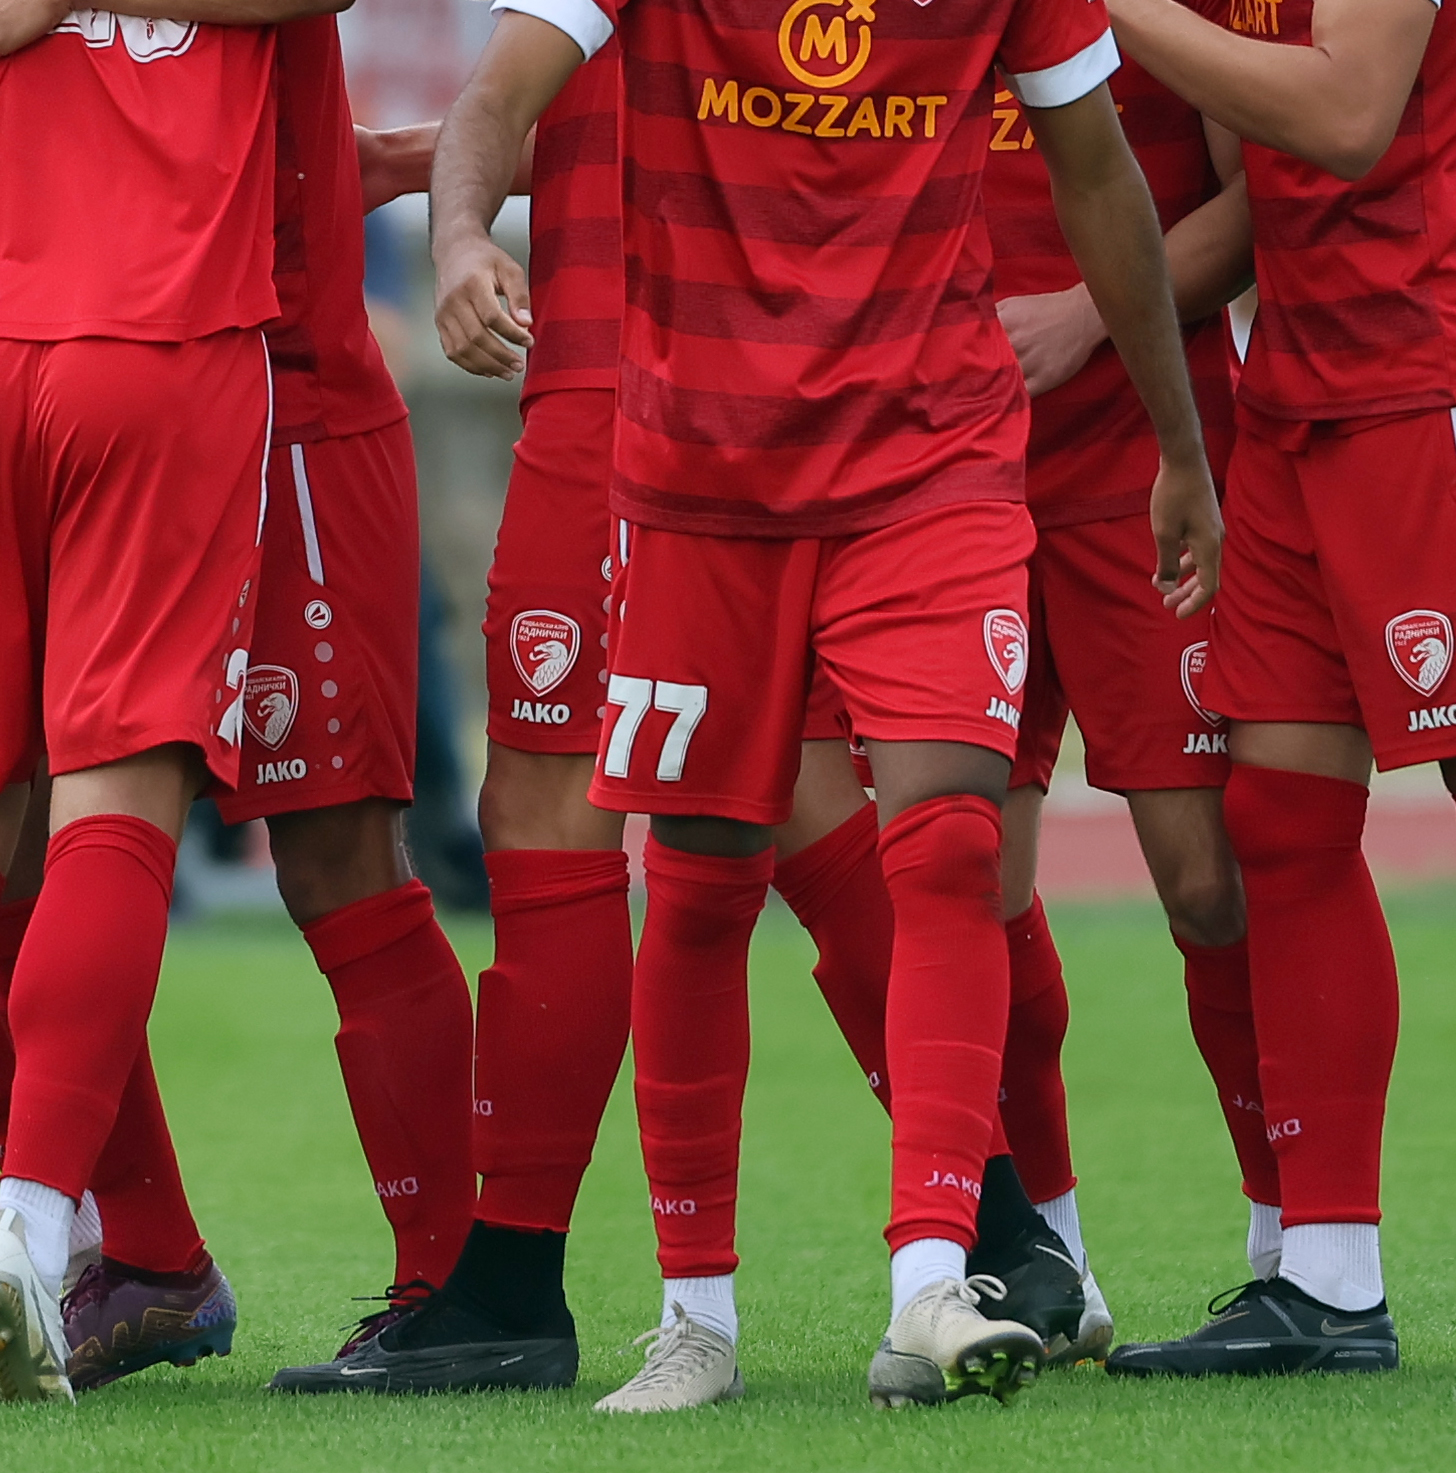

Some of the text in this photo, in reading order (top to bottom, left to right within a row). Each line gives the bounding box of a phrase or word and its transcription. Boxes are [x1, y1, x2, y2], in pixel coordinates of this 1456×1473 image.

[697, 77, 948, 139] MOZZART
[511, 698, 570, 725] JAKO
[605, 673, 707, 782] 77
[1183, 733, 1230, 754] JAK
[256, 758, 308, 786] JAKO
[376, 1176, 419, 1198] AKO
[924, 1170, 982, 1200] JAKO
